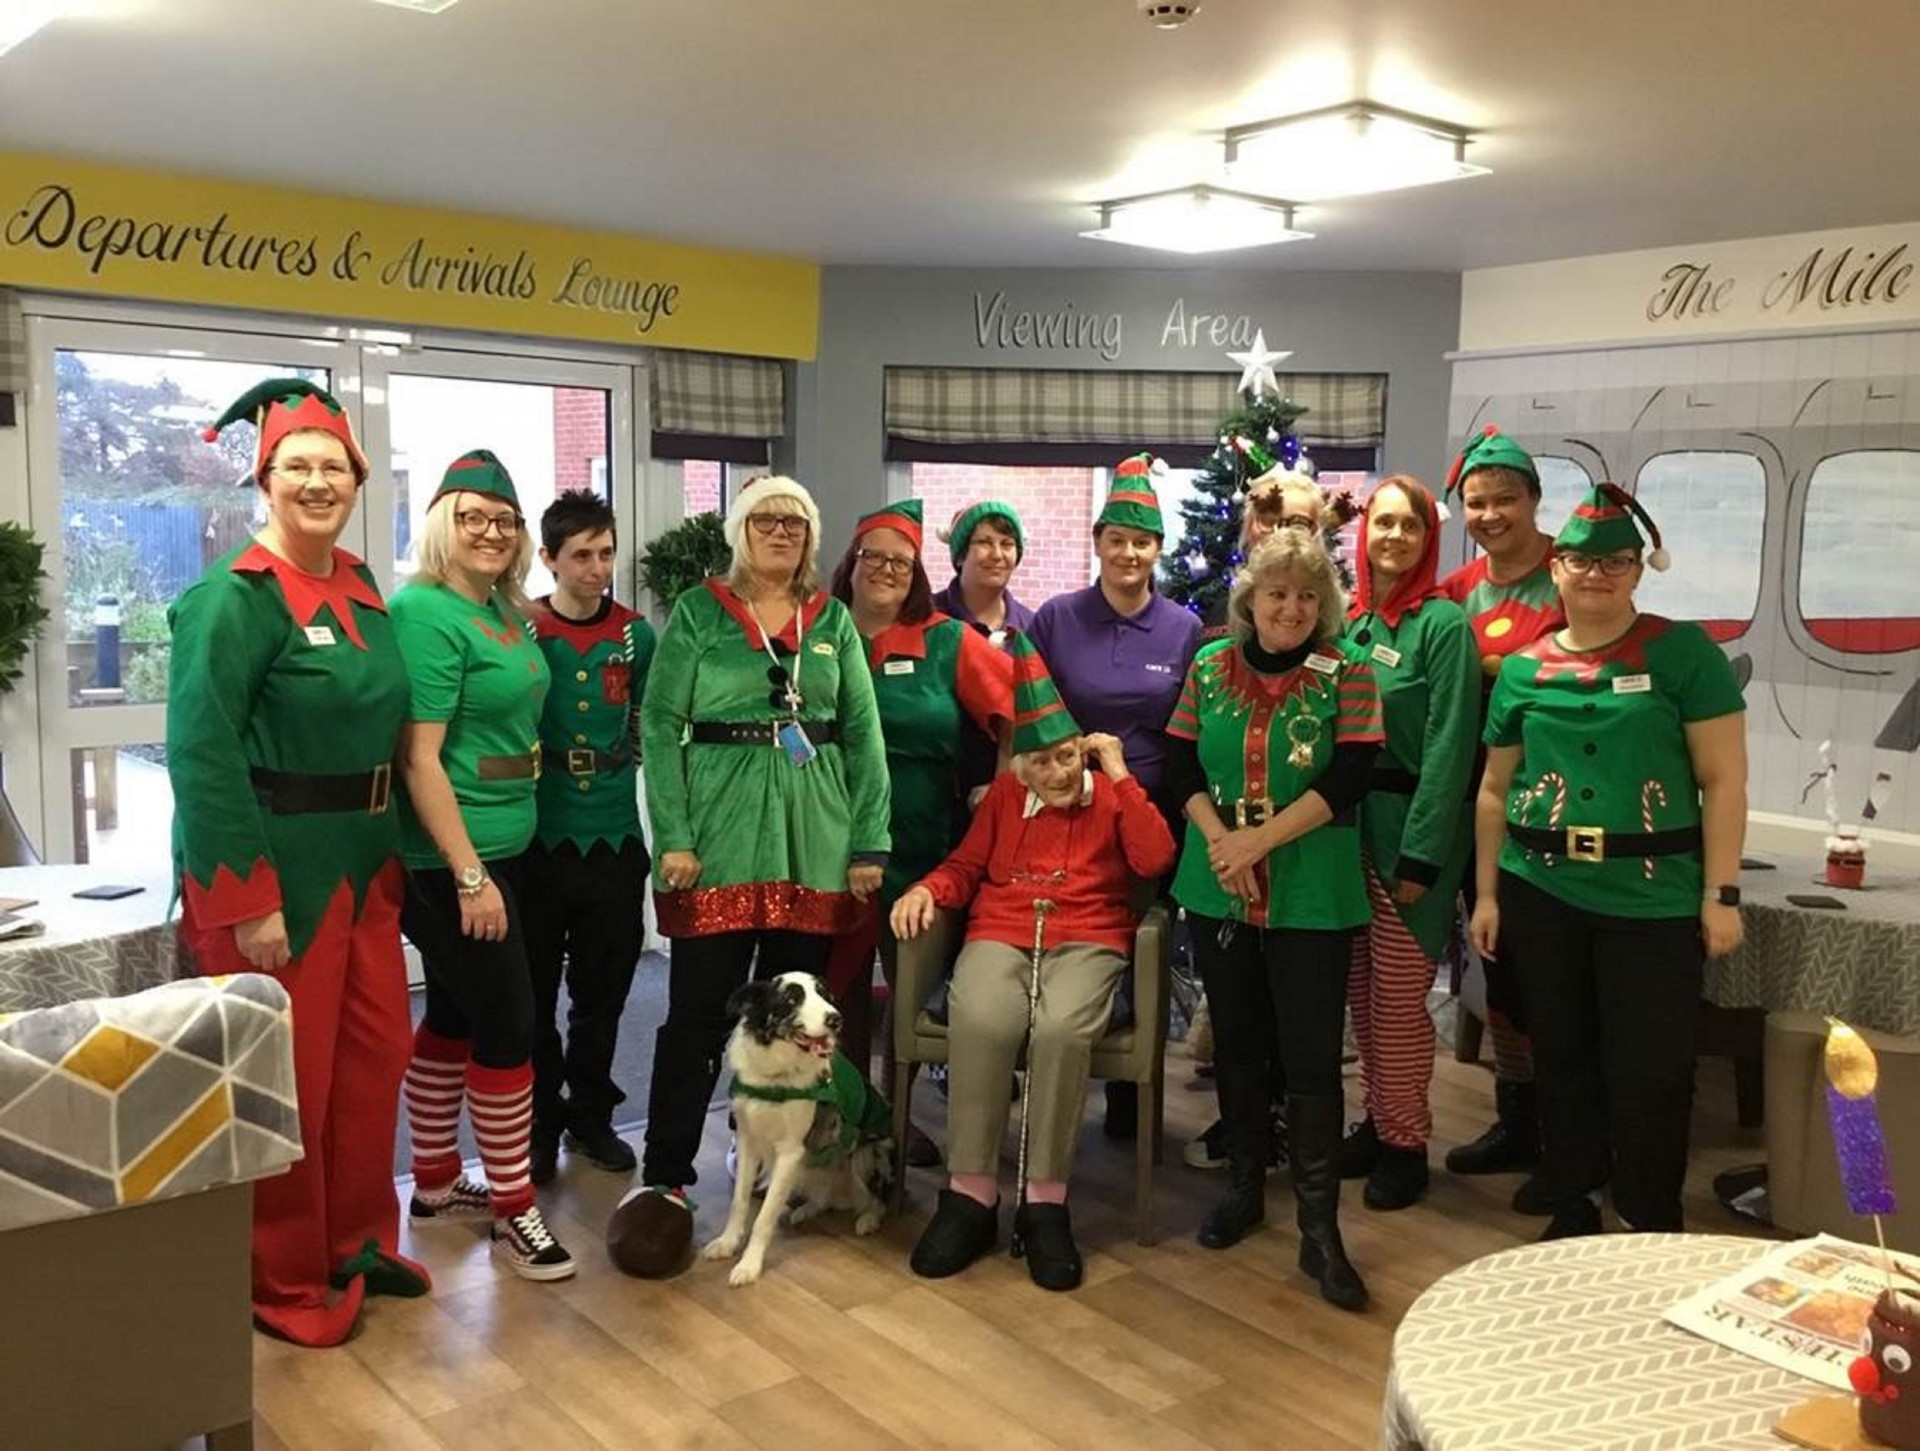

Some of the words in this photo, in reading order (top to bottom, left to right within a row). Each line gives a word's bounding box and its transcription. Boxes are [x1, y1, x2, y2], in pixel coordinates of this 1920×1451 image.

[5, 184, 318, 275] Departures
[333, 230, 372, 281] &
[380, 237, 537, 300] Arrivals
[551, 258, 680, 334] Lounge
[1646, 262, 1736, 322] The
[1760, 243, 1914, 313] Mile
[973, 290, 1123, 361] Viewing
[1160, 298, 1252, 347] Area
